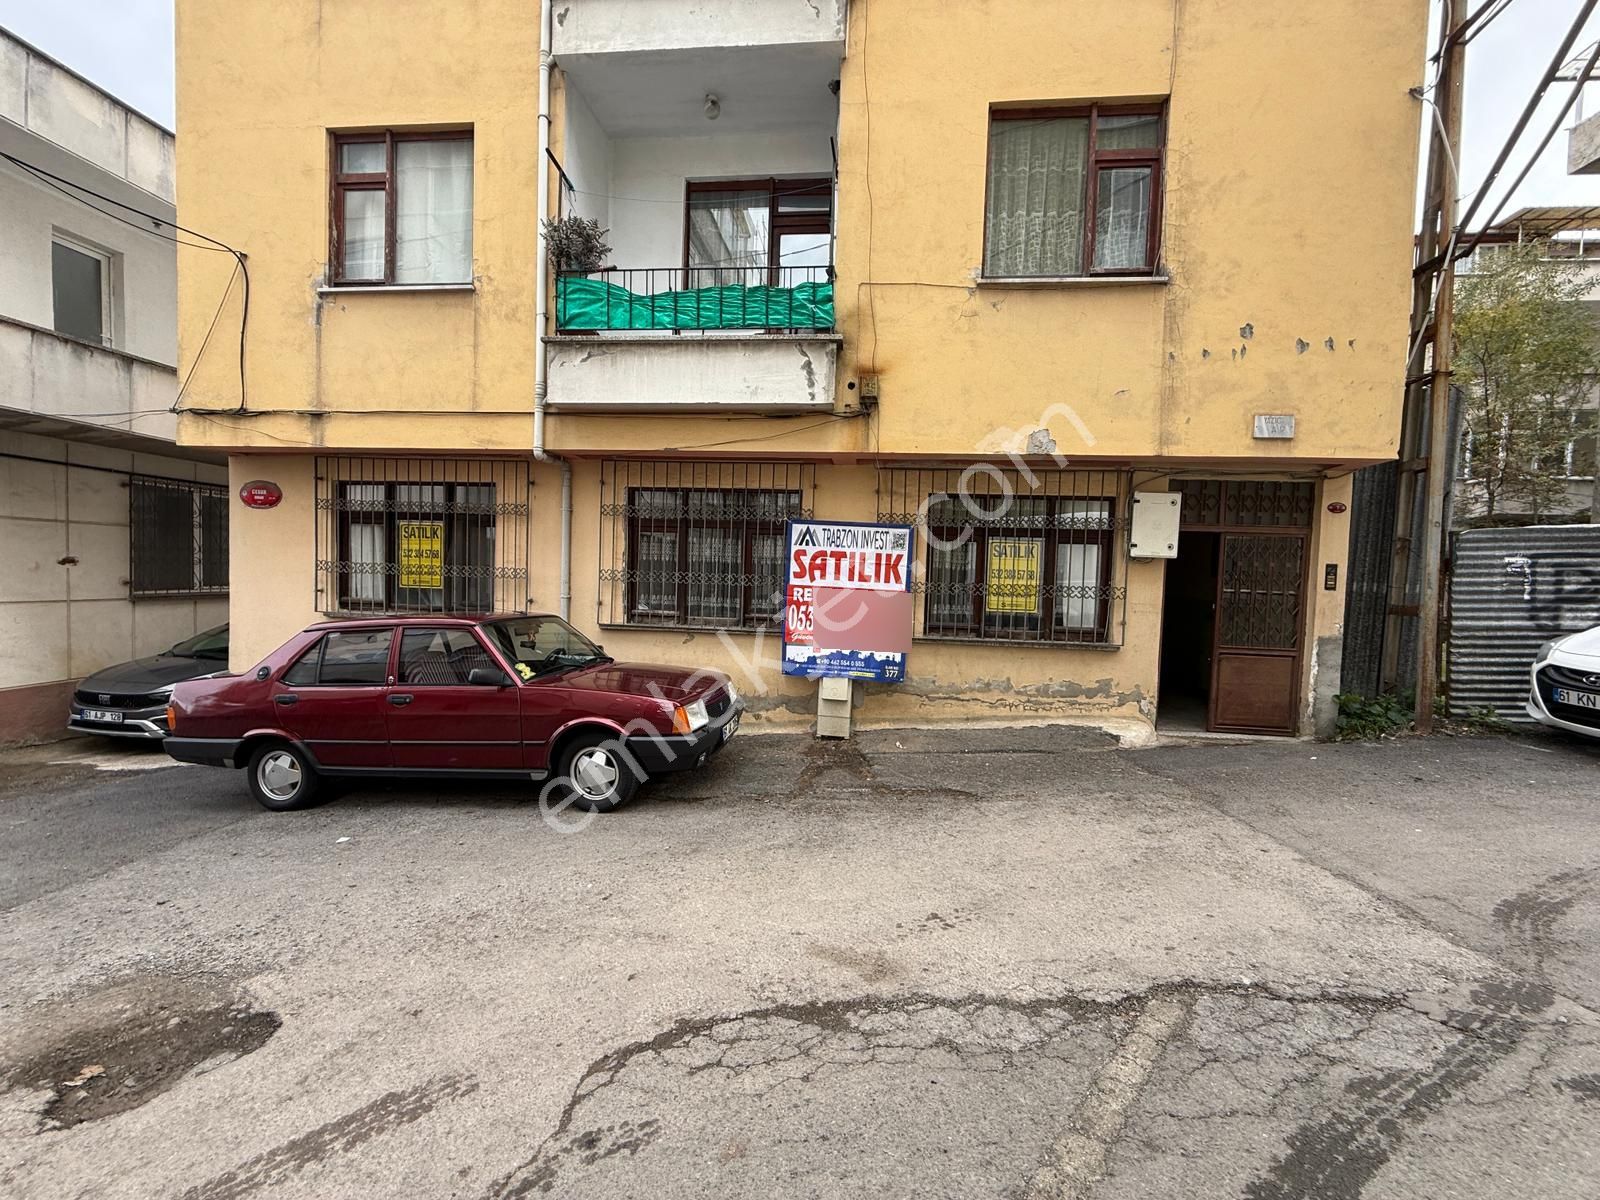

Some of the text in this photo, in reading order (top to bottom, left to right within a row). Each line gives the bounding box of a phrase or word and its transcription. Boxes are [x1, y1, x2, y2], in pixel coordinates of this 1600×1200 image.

[403, 526, 439, 539] SATILIK
[822, 528, 890, 550] TRABZON INVEST
[792, 549, 904, 585] SATILIK
[885, 669, 898, 678] 377
[1559, 690, 1570, 703] 61
